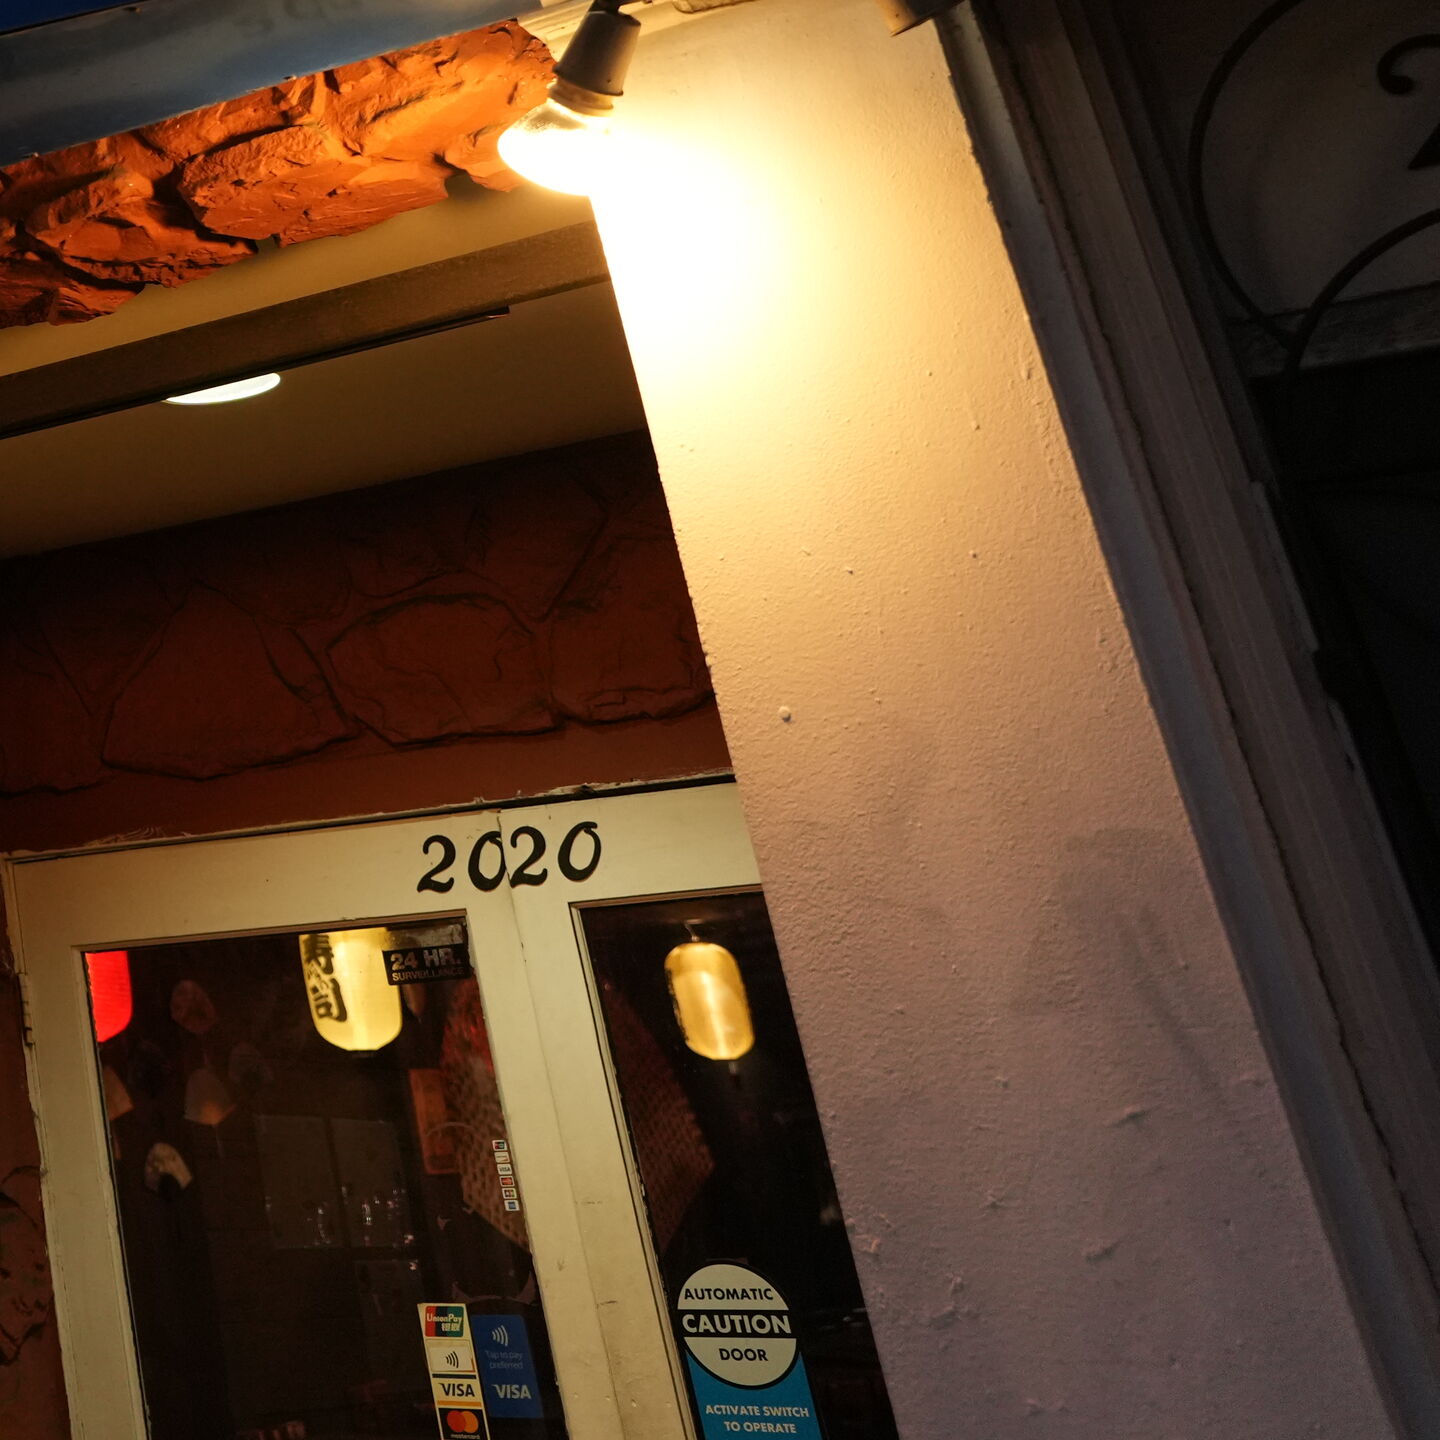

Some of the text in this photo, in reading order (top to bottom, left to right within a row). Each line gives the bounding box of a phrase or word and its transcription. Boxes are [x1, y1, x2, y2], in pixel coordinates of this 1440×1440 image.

[416, 821, 603, 894] 2020
[390, 948, 462, 971] 24 HR.
[684, 1287, 774, 1301] AUTOMATIC
[682, 1314, 793, 1334] CAUTION
[718, 1348, 769, 1362] DOOR
[439, 1382, 476, 1397] VISA
[491, 1384, 532, 1399] VISA
[705, 1404, 810, 1418] ACTIVATE SWITCH
[723, 1421, 797, 1434] TO OPERATE
